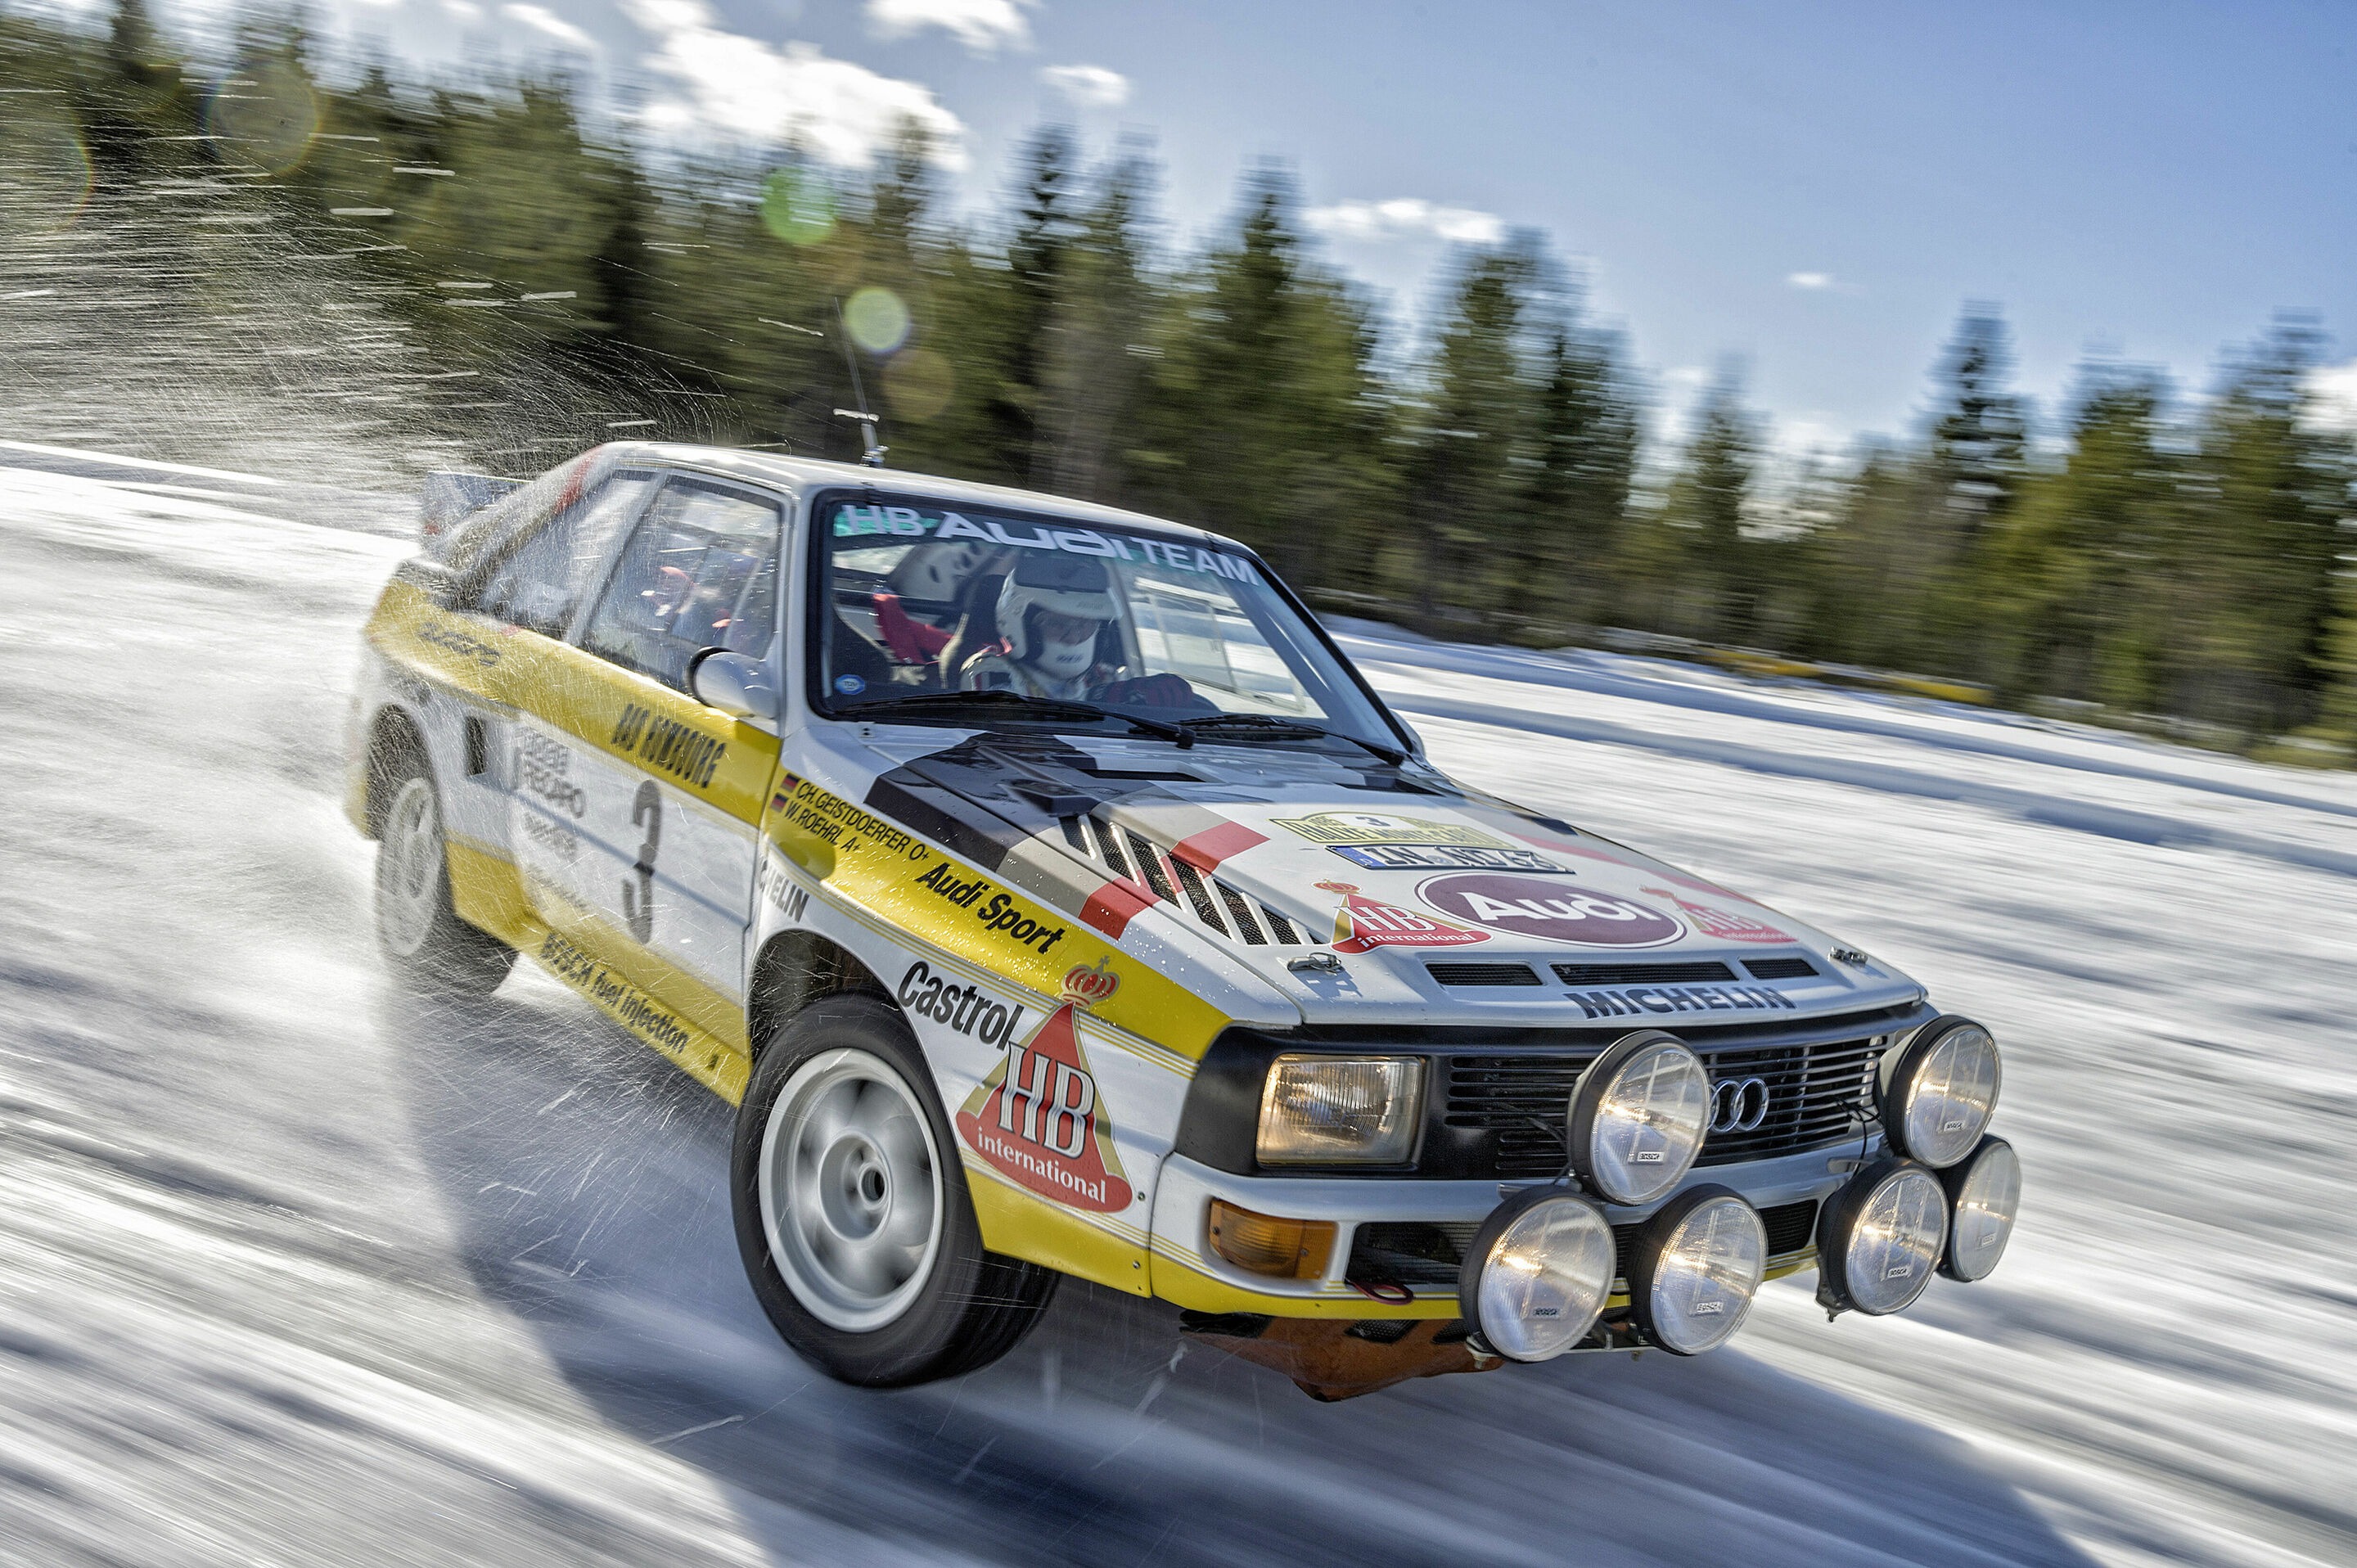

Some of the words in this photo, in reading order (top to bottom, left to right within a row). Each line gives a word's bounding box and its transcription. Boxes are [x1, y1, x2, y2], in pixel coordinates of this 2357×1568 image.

[841, 505, 926, 536] HB
[1129, 536, 1260, 587] TEAM
[622, 779, 662, 944] 3
[784, 800, 845, 845] W.ROEHRL
[916, 862, 990, 908] Audi
[977, 893, 1066, 954] Sport
[1334, 906, 1437, 931] HB
[1358, 932, 1476, 948] international
[620, 989, 690, 1054] injection
[898, 961, 1025, 1052] Castrol
[1562, 987, 1796, 1020] MICHELIN
[997, 1040, 1095, 1160] HB
[978, 1126, 1106, 1205] international
